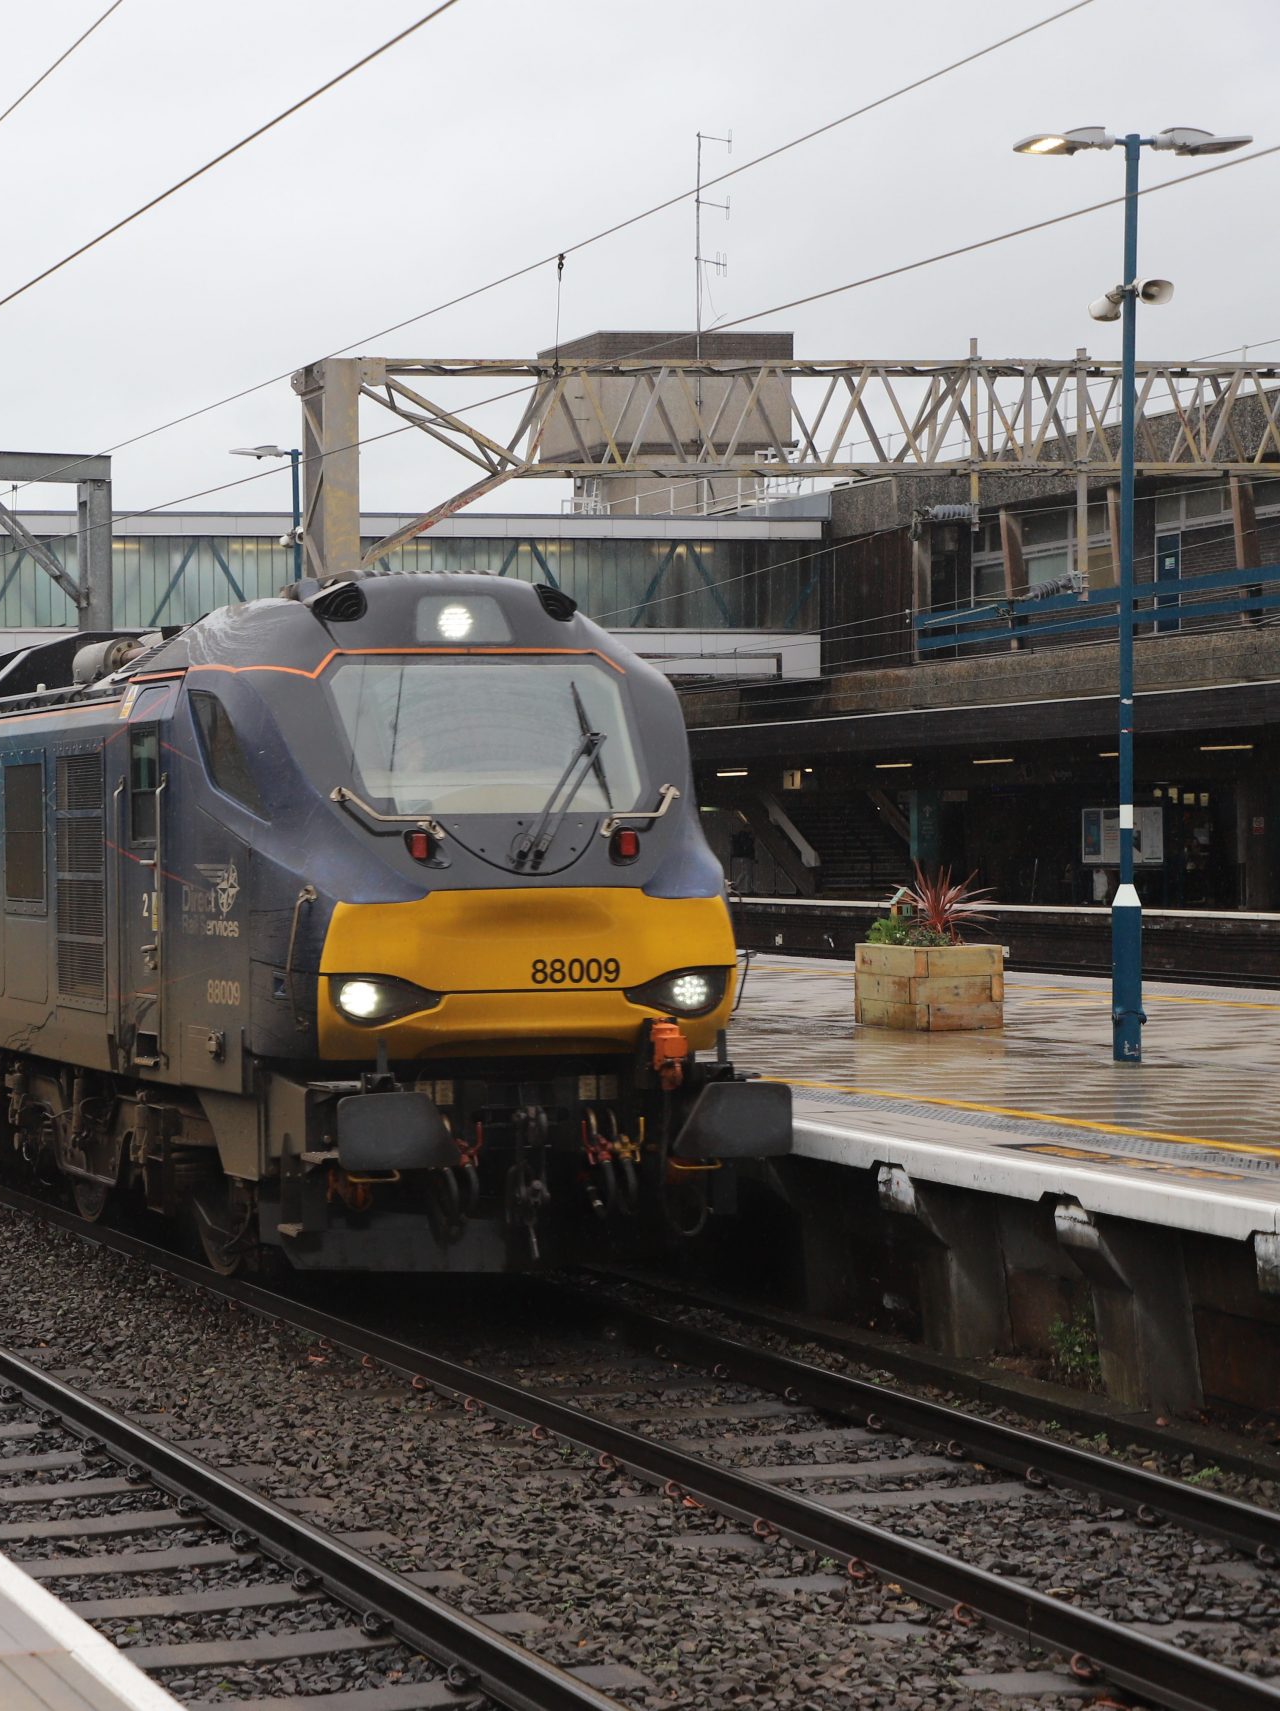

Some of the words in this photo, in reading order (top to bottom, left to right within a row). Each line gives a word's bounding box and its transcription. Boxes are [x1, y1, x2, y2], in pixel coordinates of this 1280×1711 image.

[789, 771, 795, 787] 1
[142, 892, 150, 917] 2
[182, 885, 217, 913] Direct
[202, 914, 240, 938] Services
[531, 957, 621, 985] 88009
[207, 979, 241, 1006] 88009
